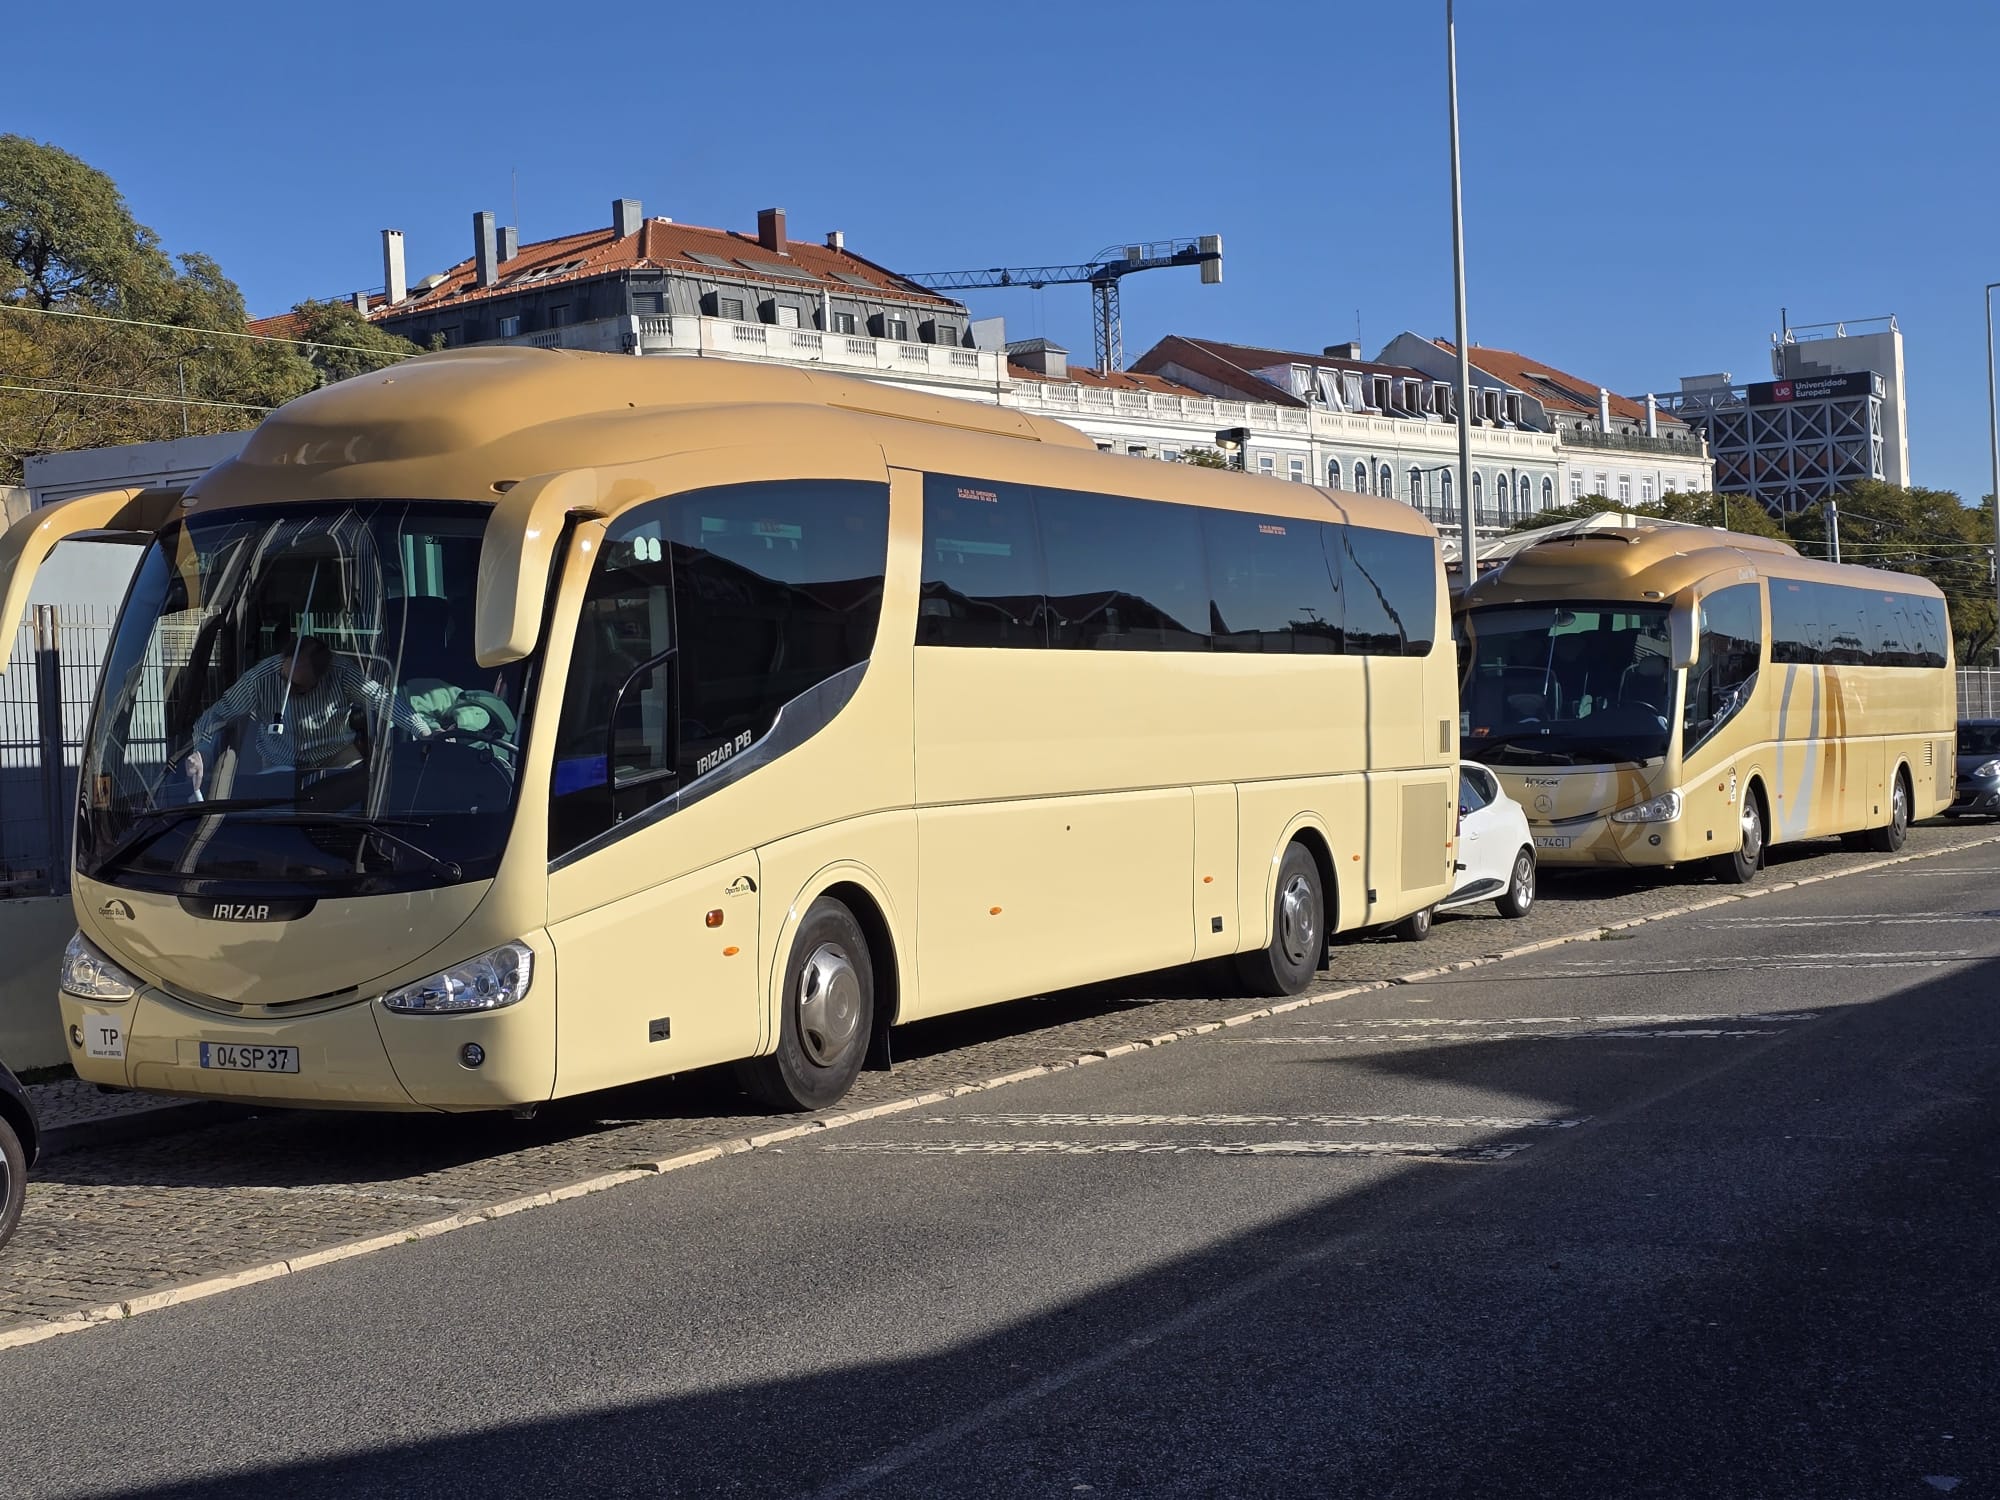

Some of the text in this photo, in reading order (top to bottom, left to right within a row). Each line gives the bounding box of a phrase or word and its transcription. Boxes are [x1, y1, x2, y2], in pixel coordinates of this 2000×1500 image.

[1795, 379, 1847, 390] Universidade
[1796, 388, 1831, 397] Europeia
[696, 729, 752, 776] IRIZAR PB
[212, 904, 270, 920] IRIZAR
[100, 1028, 119, 1046] TP
